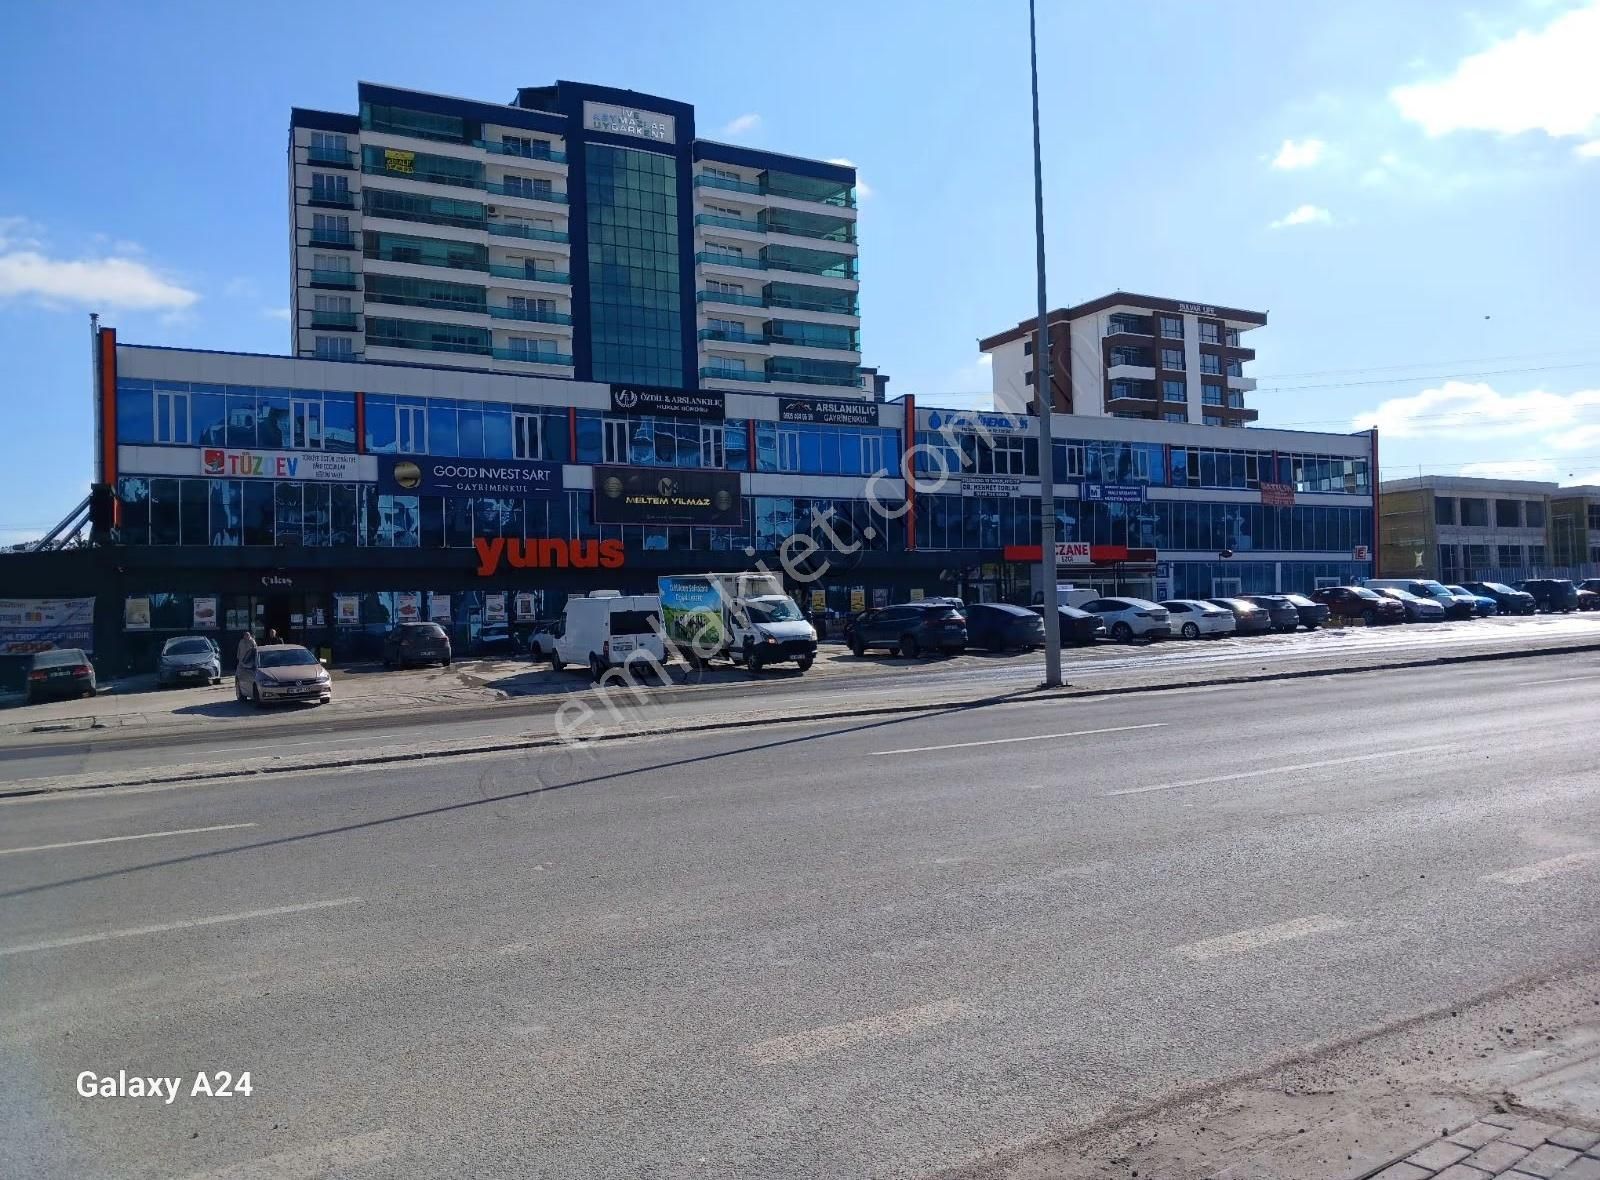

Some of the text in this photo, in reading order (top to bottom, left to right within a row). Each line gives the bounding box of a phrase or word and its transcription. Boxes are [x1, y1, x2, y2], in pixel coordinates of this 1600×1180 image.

[816, 403, 876, 416] ARSLANKILIÇ
[433, 465, 551, 481] GOOD INVEST SART
[625, 496, 711, 506] MELTEM YILMAZ
[473, 537, 625, 576] yunus
